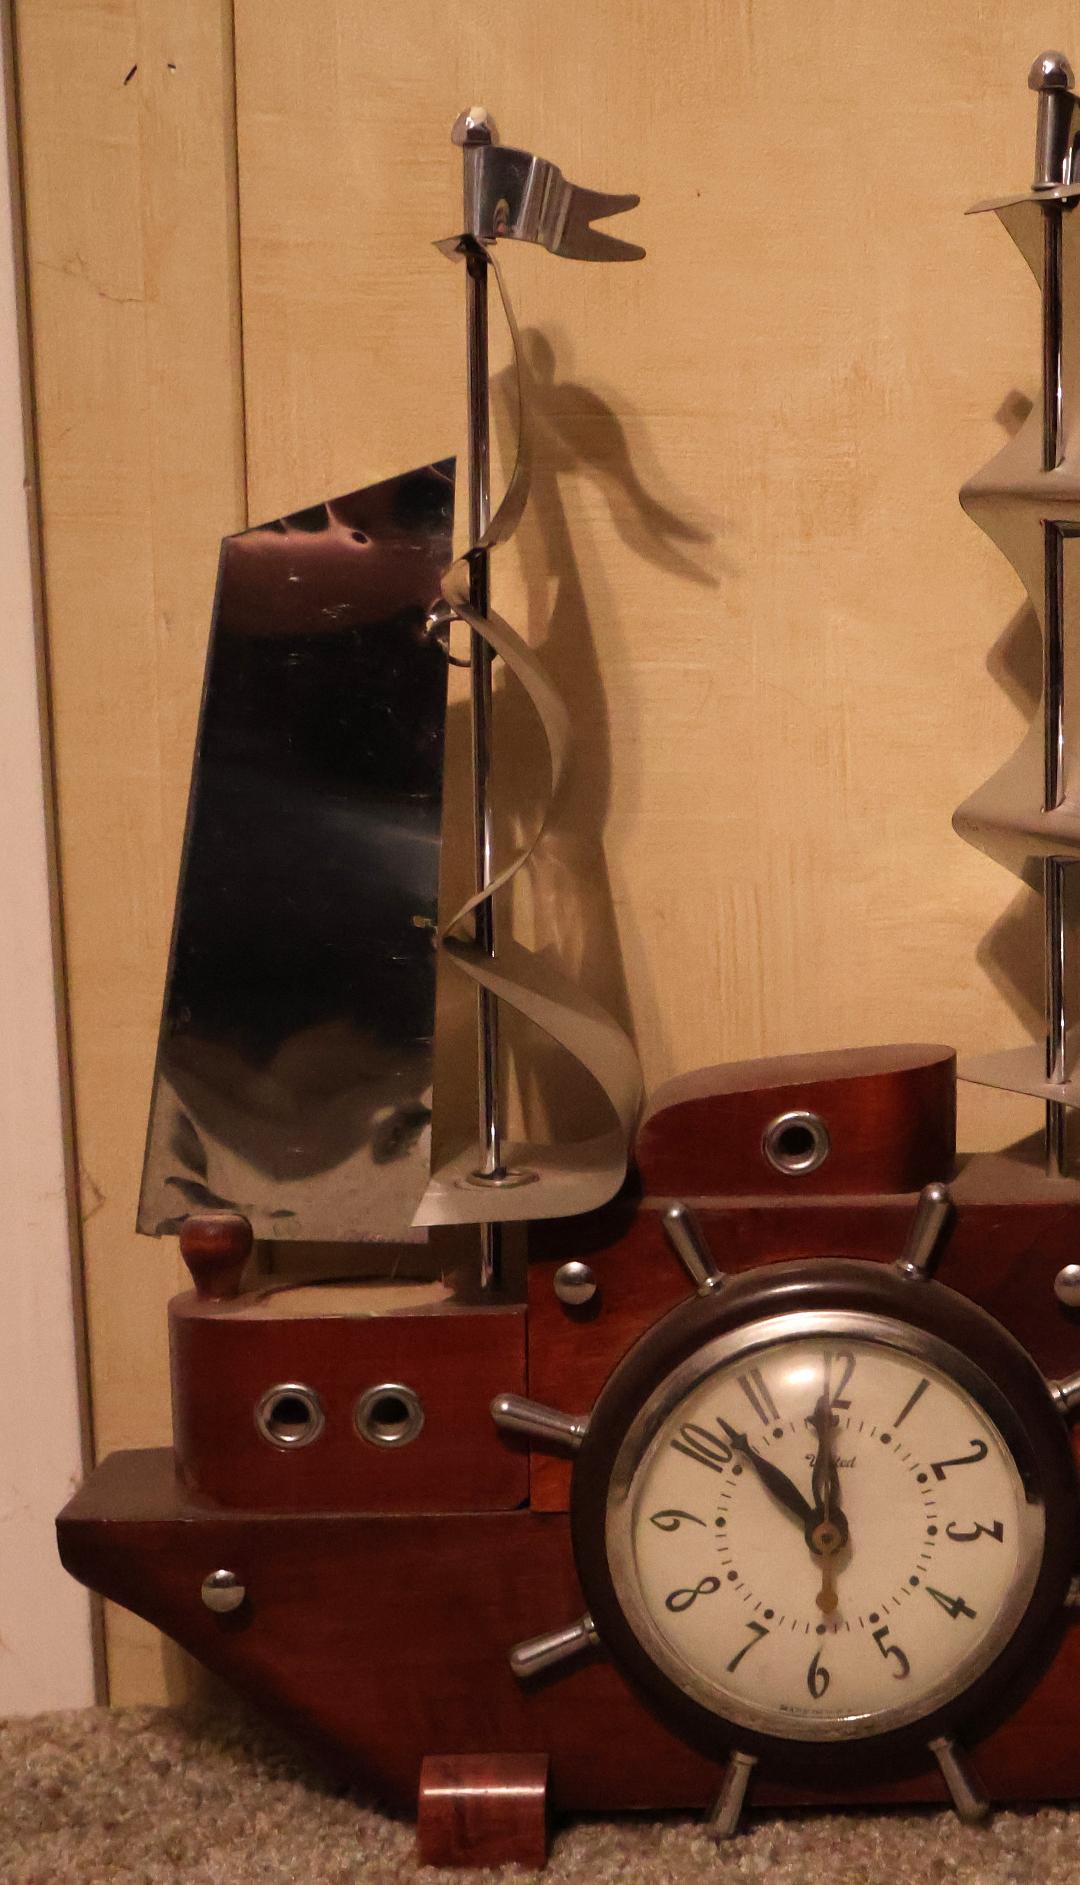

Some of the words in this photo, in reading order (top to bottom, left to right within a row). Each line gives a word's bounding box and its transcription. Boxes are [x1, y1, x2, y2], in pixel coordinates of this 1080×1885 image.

[737, 1367, 780, 1424] 11
[894, 1378, 930, 1428] 1
[670, 1422, 733, 1473] 10
[930, 1439, 989, 1482] 2
[650, 1508, 707, 1533] 9
[945, 1519, 1004, 1544] 3
[665, 1575, 721, 1613] 8
[925, 1585, 977, 1621] 4
[726, 1620, 770, 1674] 7
[871, 1625, 911, 1680] 5
[806, 1645, 831, 1700] 6
